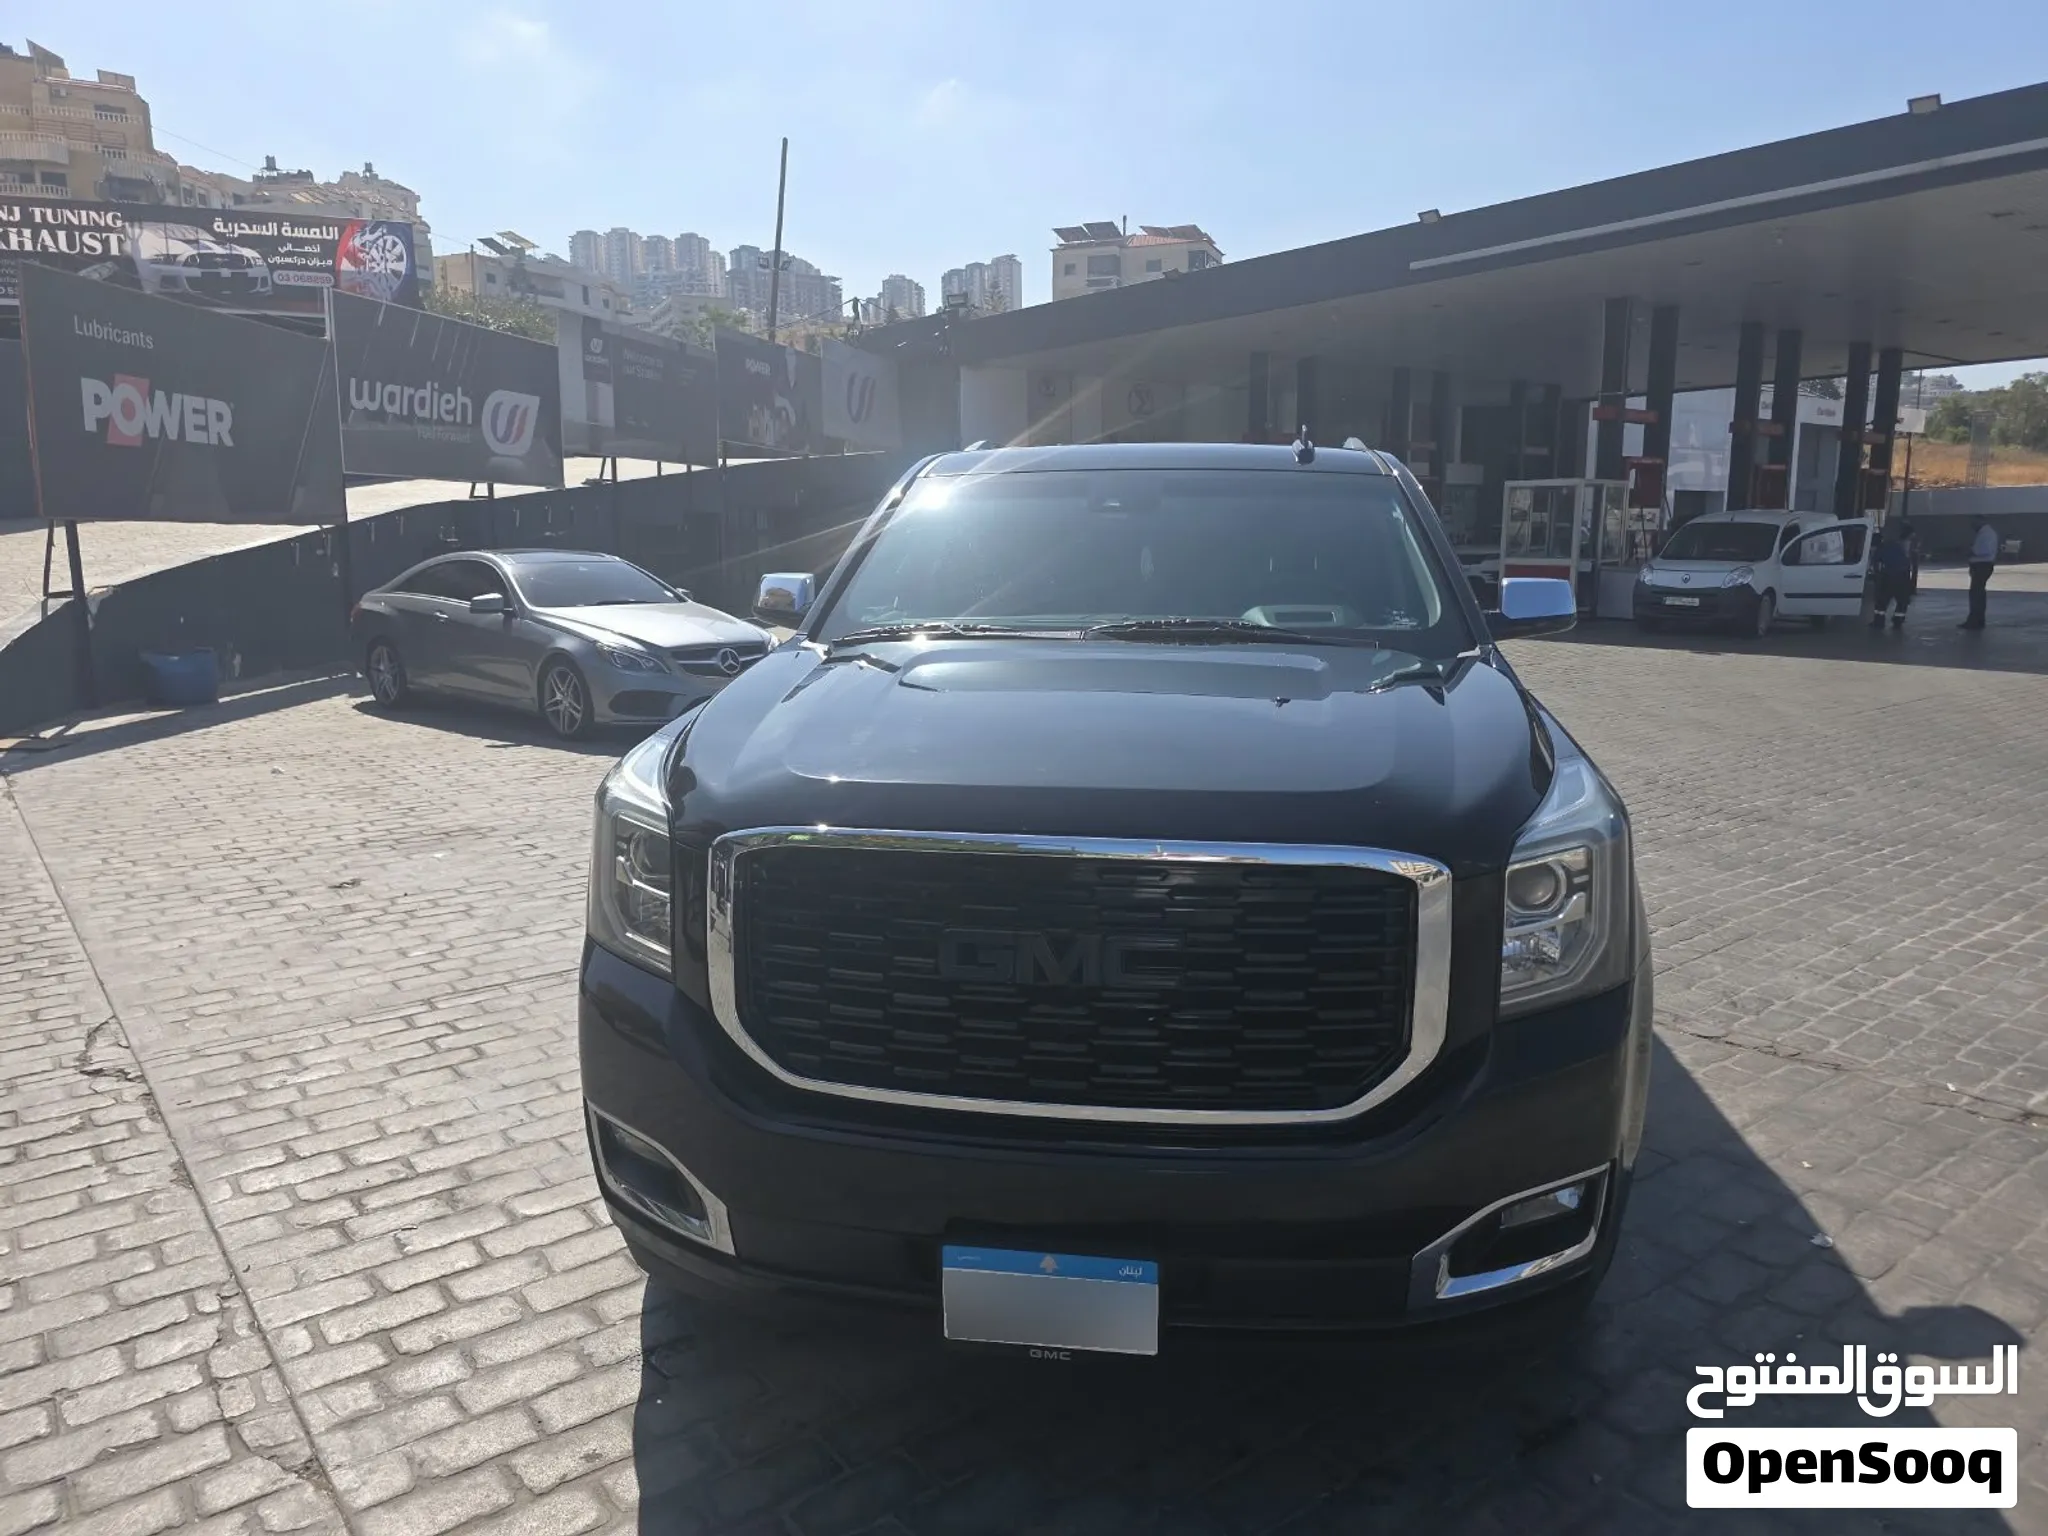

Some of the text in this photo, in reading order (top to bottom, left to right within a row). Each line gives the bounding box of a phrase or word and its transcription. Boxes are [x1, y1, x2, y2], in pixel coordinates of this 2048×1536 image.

[29, 206, 122, 228] TUNING
[213, 217, 339, 240] اللمسة السحرية
[74, 314, 154, 349] Lubricants
[80, 376, 234, 447] POWER
[350, 377, 472, 425] wardieh
[938, 927, 1185, 989] GMC
[1118, 1265, 1143, 1279] لبنان
[1029, 1348, 1071, 1361] GMC
